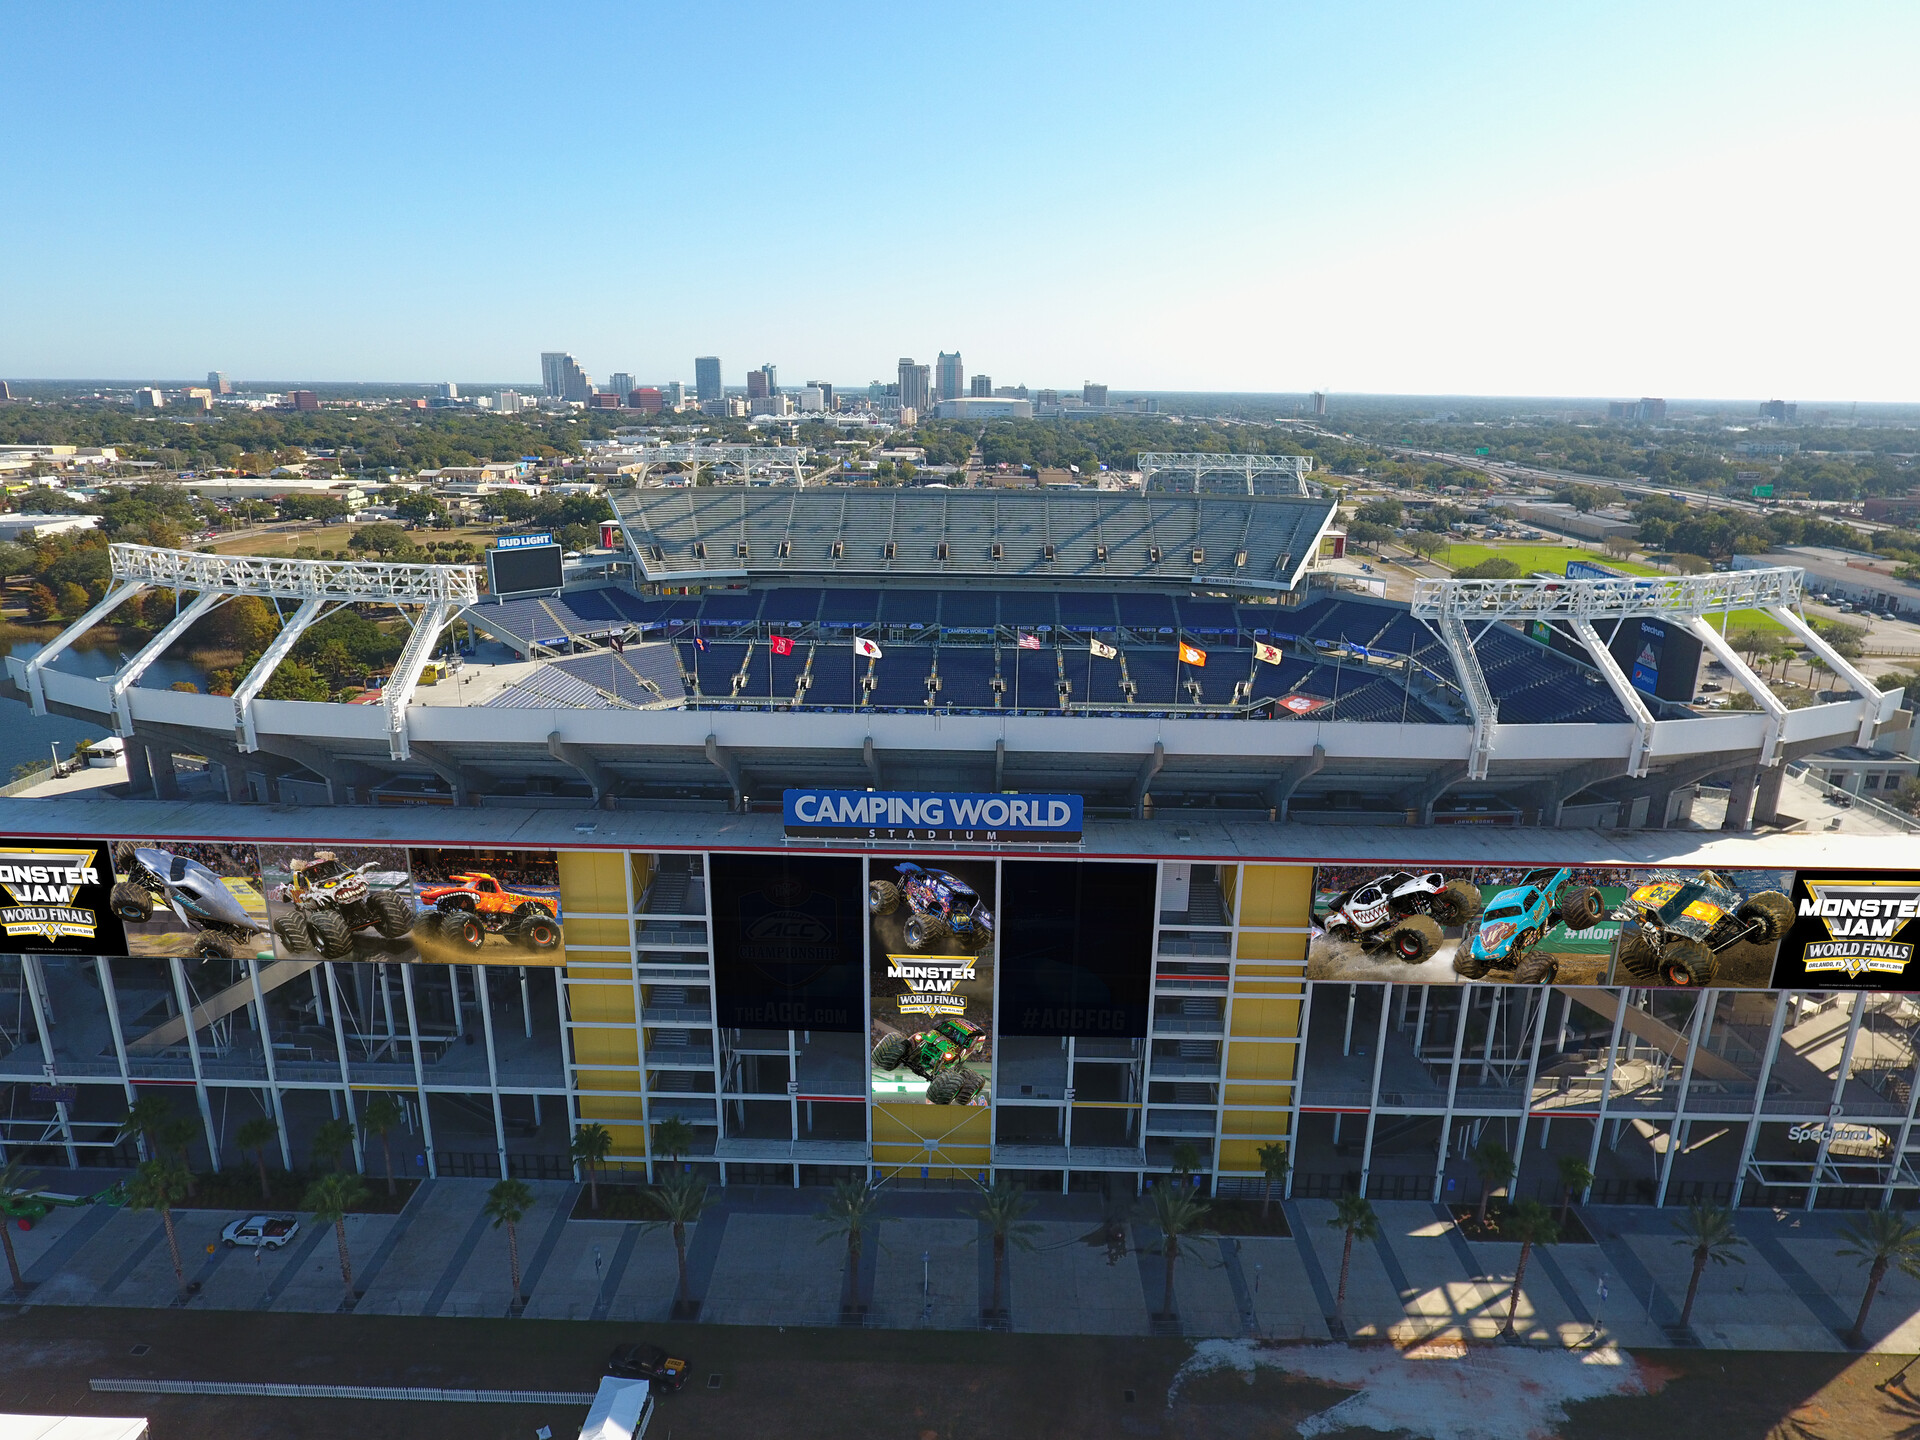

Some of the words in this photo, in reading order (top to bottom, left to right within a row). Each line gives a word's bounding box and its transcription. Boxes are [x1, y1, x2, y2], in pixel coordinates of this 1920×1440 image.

[499, 538, 520, 547] BUD
[521, 535, 550, 545] LIGHT
[1641, 622, 1665, 638] Spectrum
[794, 795, 944, 825] CAMPING
[949, 798, 1071, 827] WORLD
[868, 828, 998, 841] STADIUM
[0, 865, 100, 885] ONSTER
[16, 884, 70, 903] JAM
[2, 908, 48, 922] WORLD
[49, 909, 93, 924] FINALS
[1798, 898, 1920, 918] MONSTE
[760, 922, 817, 937] ACC
[1831, 918, 1896, 937] JAM
[739, 945, 840, 960] CHAMPIONSHIP
[1809, 942, 1860, 958] WORLD
[1861, 942, 1909, 959] FINALS
[887, 966, 976, 980] MONSTER
[1808, 961, 1835, 969] ORLANDO,
[912, 979, 952, 992] JAM
[900, 994, 934, 1005] WORLD
[934, 995, 965, 1006] FINALS
[1022, 1008, 1126, 1030] #ACCFCG
